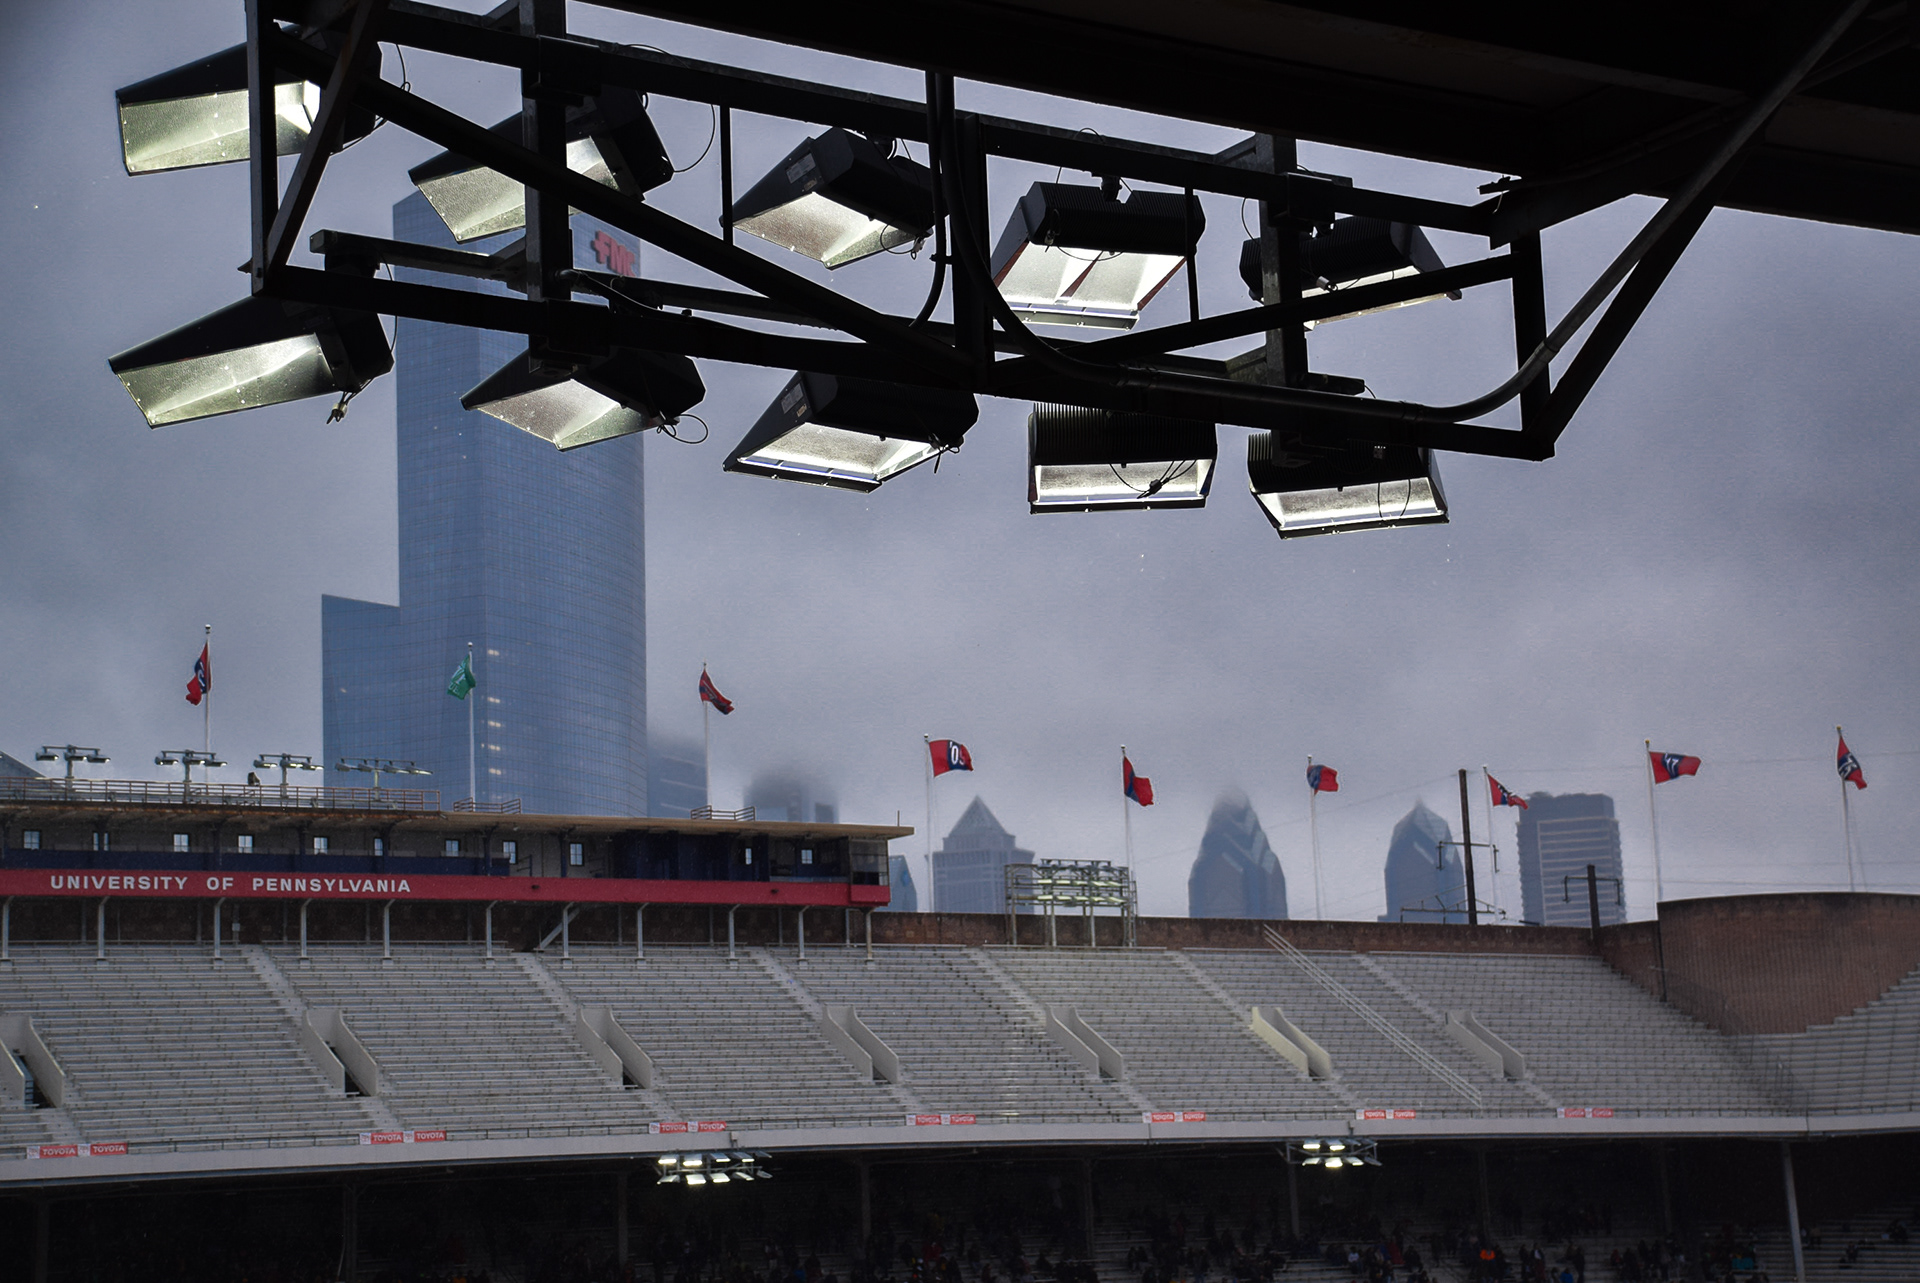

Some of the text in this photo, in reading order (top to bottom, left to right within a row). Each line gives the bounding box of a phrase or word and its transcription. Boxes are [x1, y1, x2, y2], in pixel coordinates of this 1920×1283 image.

[50, 875, 411, 893] UNIVERSITY OF PENNSYLVANIA
[373, 1134, 402, 1142] TOYOTA
[416, 1132, 444, 1140] TOYOTA
[42, 1148, 76, 1156] TOYOTA
[93, 1145, 125, 1153] TOYOTA
